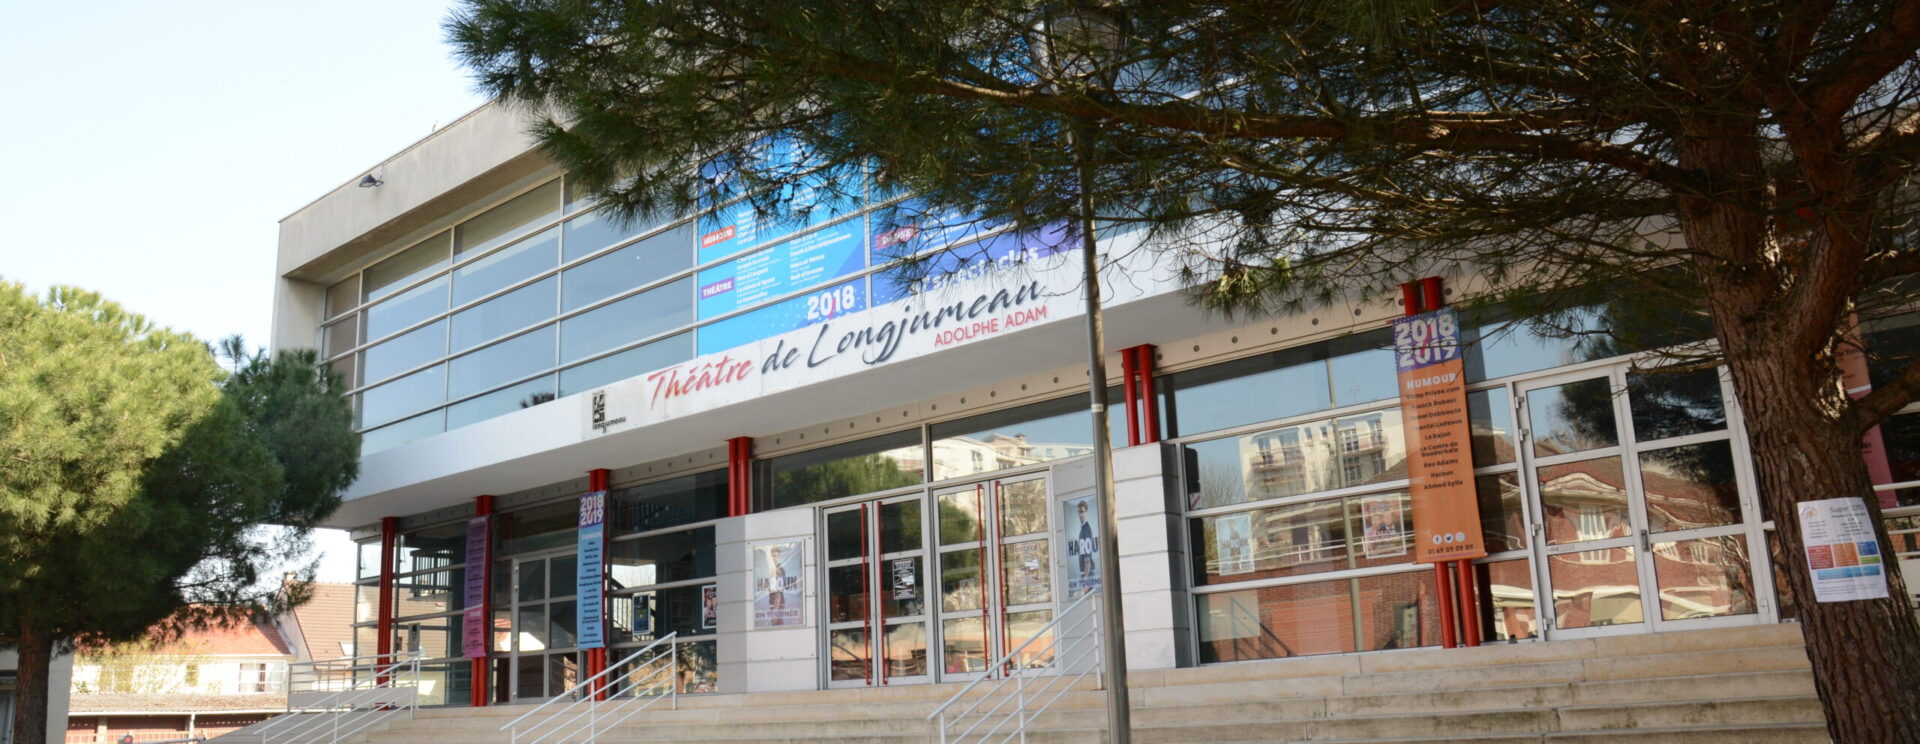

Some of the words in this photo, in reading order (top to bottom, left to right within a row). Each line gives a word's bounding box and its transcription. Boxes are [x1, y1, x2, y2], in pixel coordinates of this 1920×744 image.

[703, 281, 732, 298] THÉÂTRE
[807, 285, 854, 320] 2018
[934, 319, 999, 347] ADOLPHE
[1005, 305, 1047, 330] ADAM
[1395, 314, 1455, 346] 2018
[647, 356, 754, 408] Théâtre
[761, 339, 800, 374] de
[807, 276, 1048, 367] Longjumeau
[1397, 336, 1457, 368] 2019
[1406, 373, 1457, 389] HUMOUR
[580, 494, 605, 512] 2018
[580, 509, 604, 526] 2019
[1068, 537, 1099, 556] HAROU
[757, 575, 798, 592] HAROUN
[755, 611, 766, 619] EN
